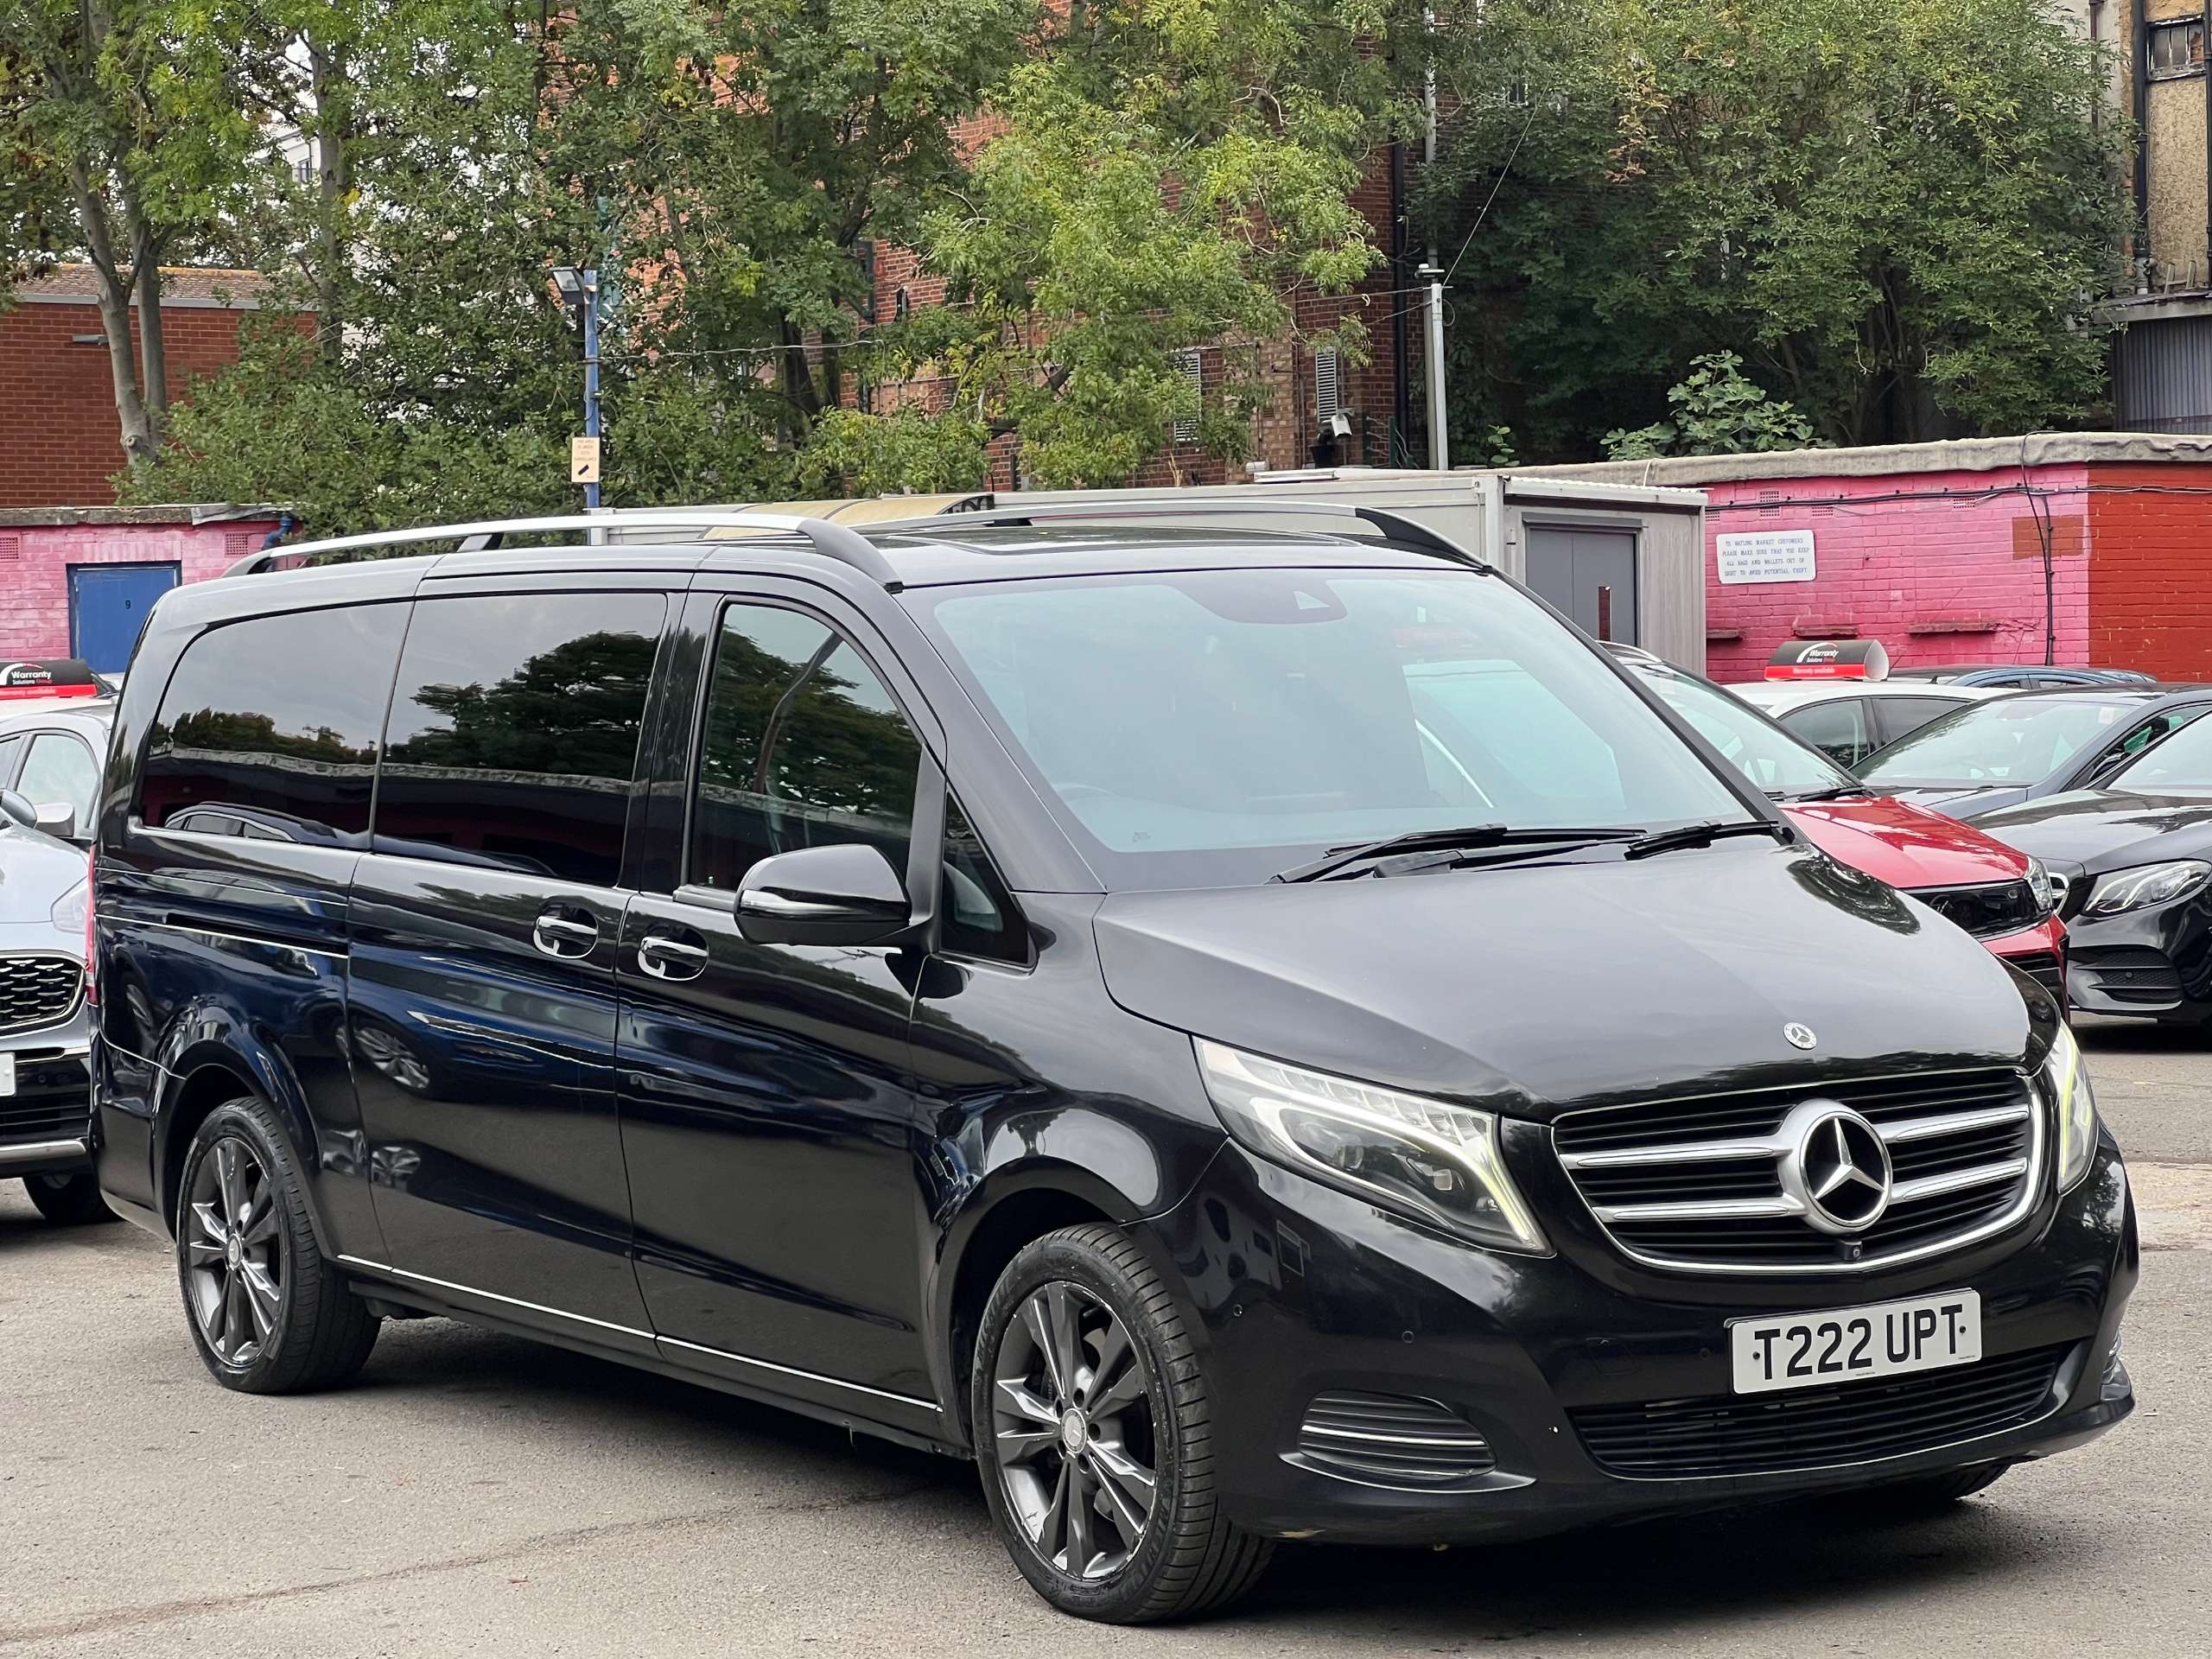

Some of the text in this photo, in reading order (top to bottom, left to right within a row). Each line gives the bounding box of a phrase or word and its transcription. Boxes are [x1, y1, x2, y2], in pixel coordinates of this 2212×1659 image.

[124, 600, 131, 609] 9
[10, 671, 52, 679] Warranty
[1754, 1303, 1963, 1381] T222 UPT
